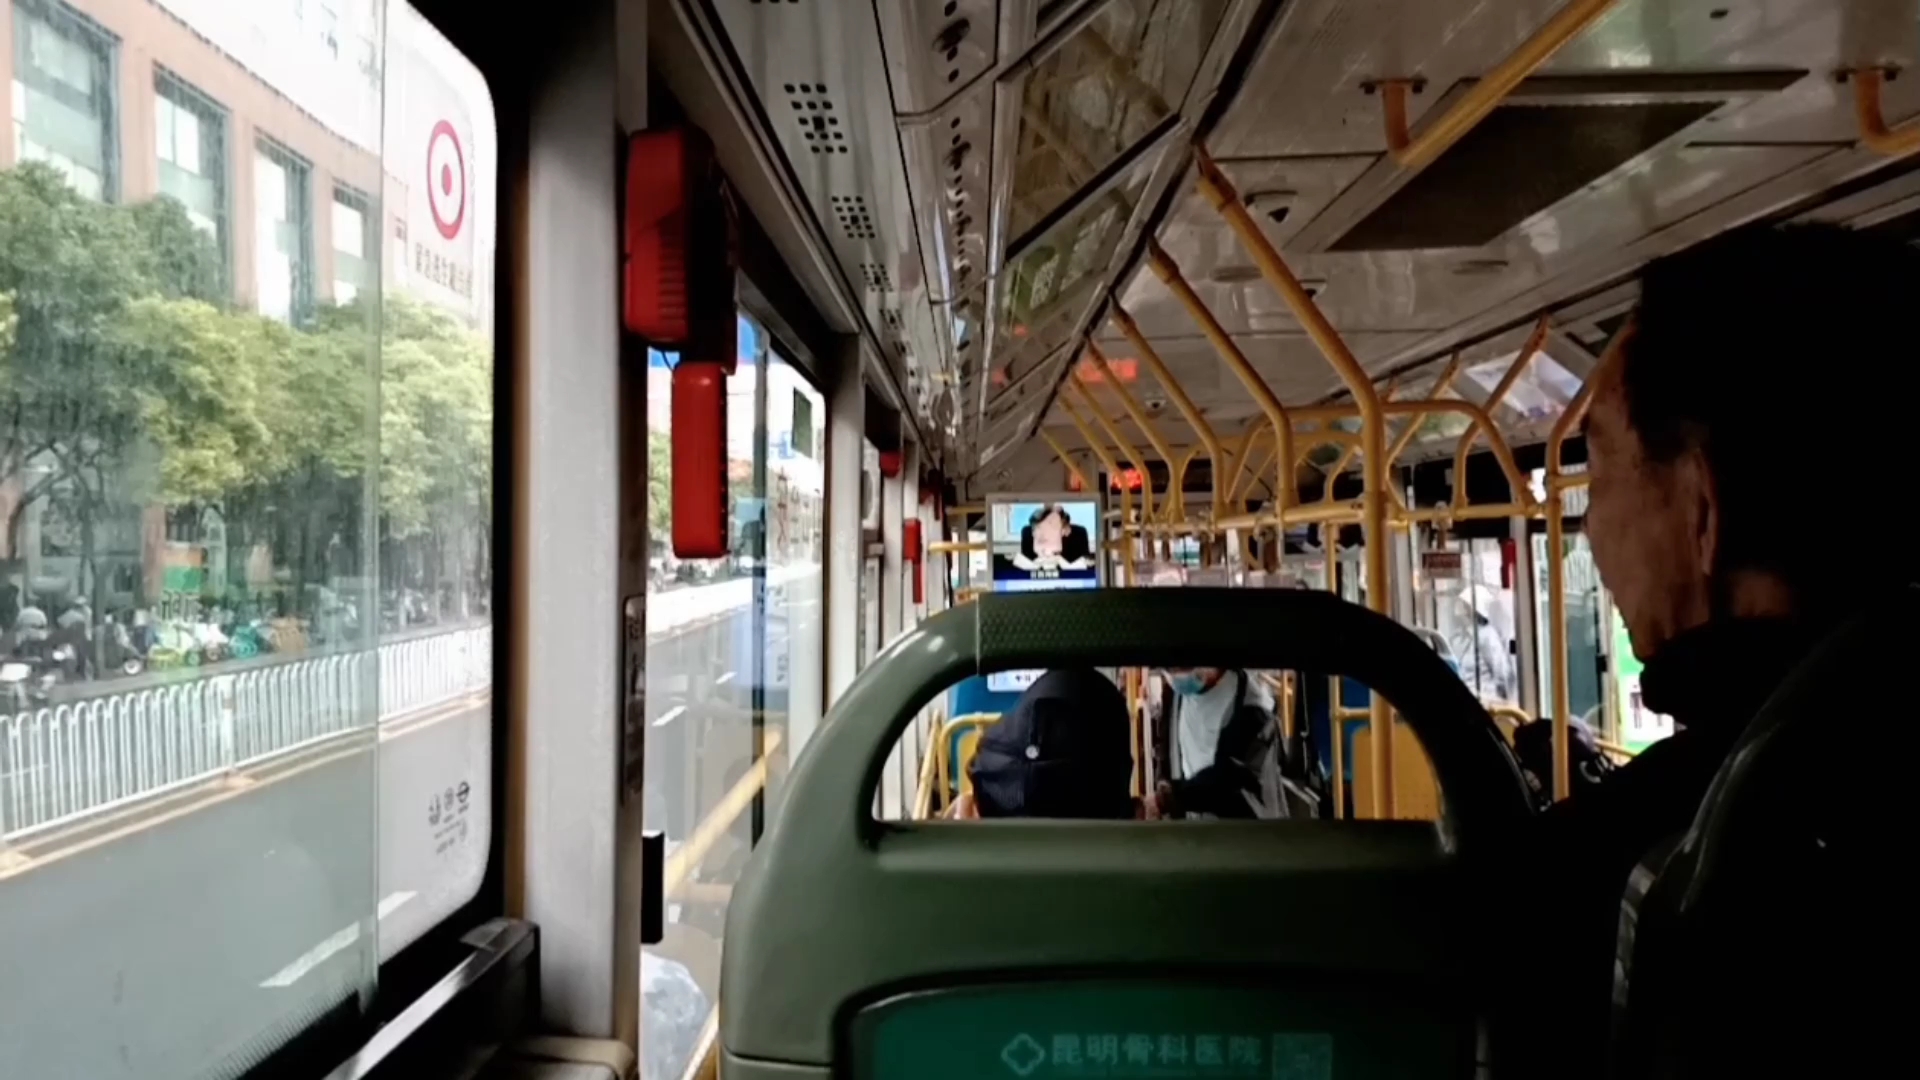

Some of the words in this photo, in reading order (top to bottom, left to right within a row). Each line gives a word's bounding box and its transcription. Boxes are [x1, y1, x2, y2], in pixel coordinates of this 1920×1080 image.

[1052, 1033, 1261, 1066] 昆明骨科医院
